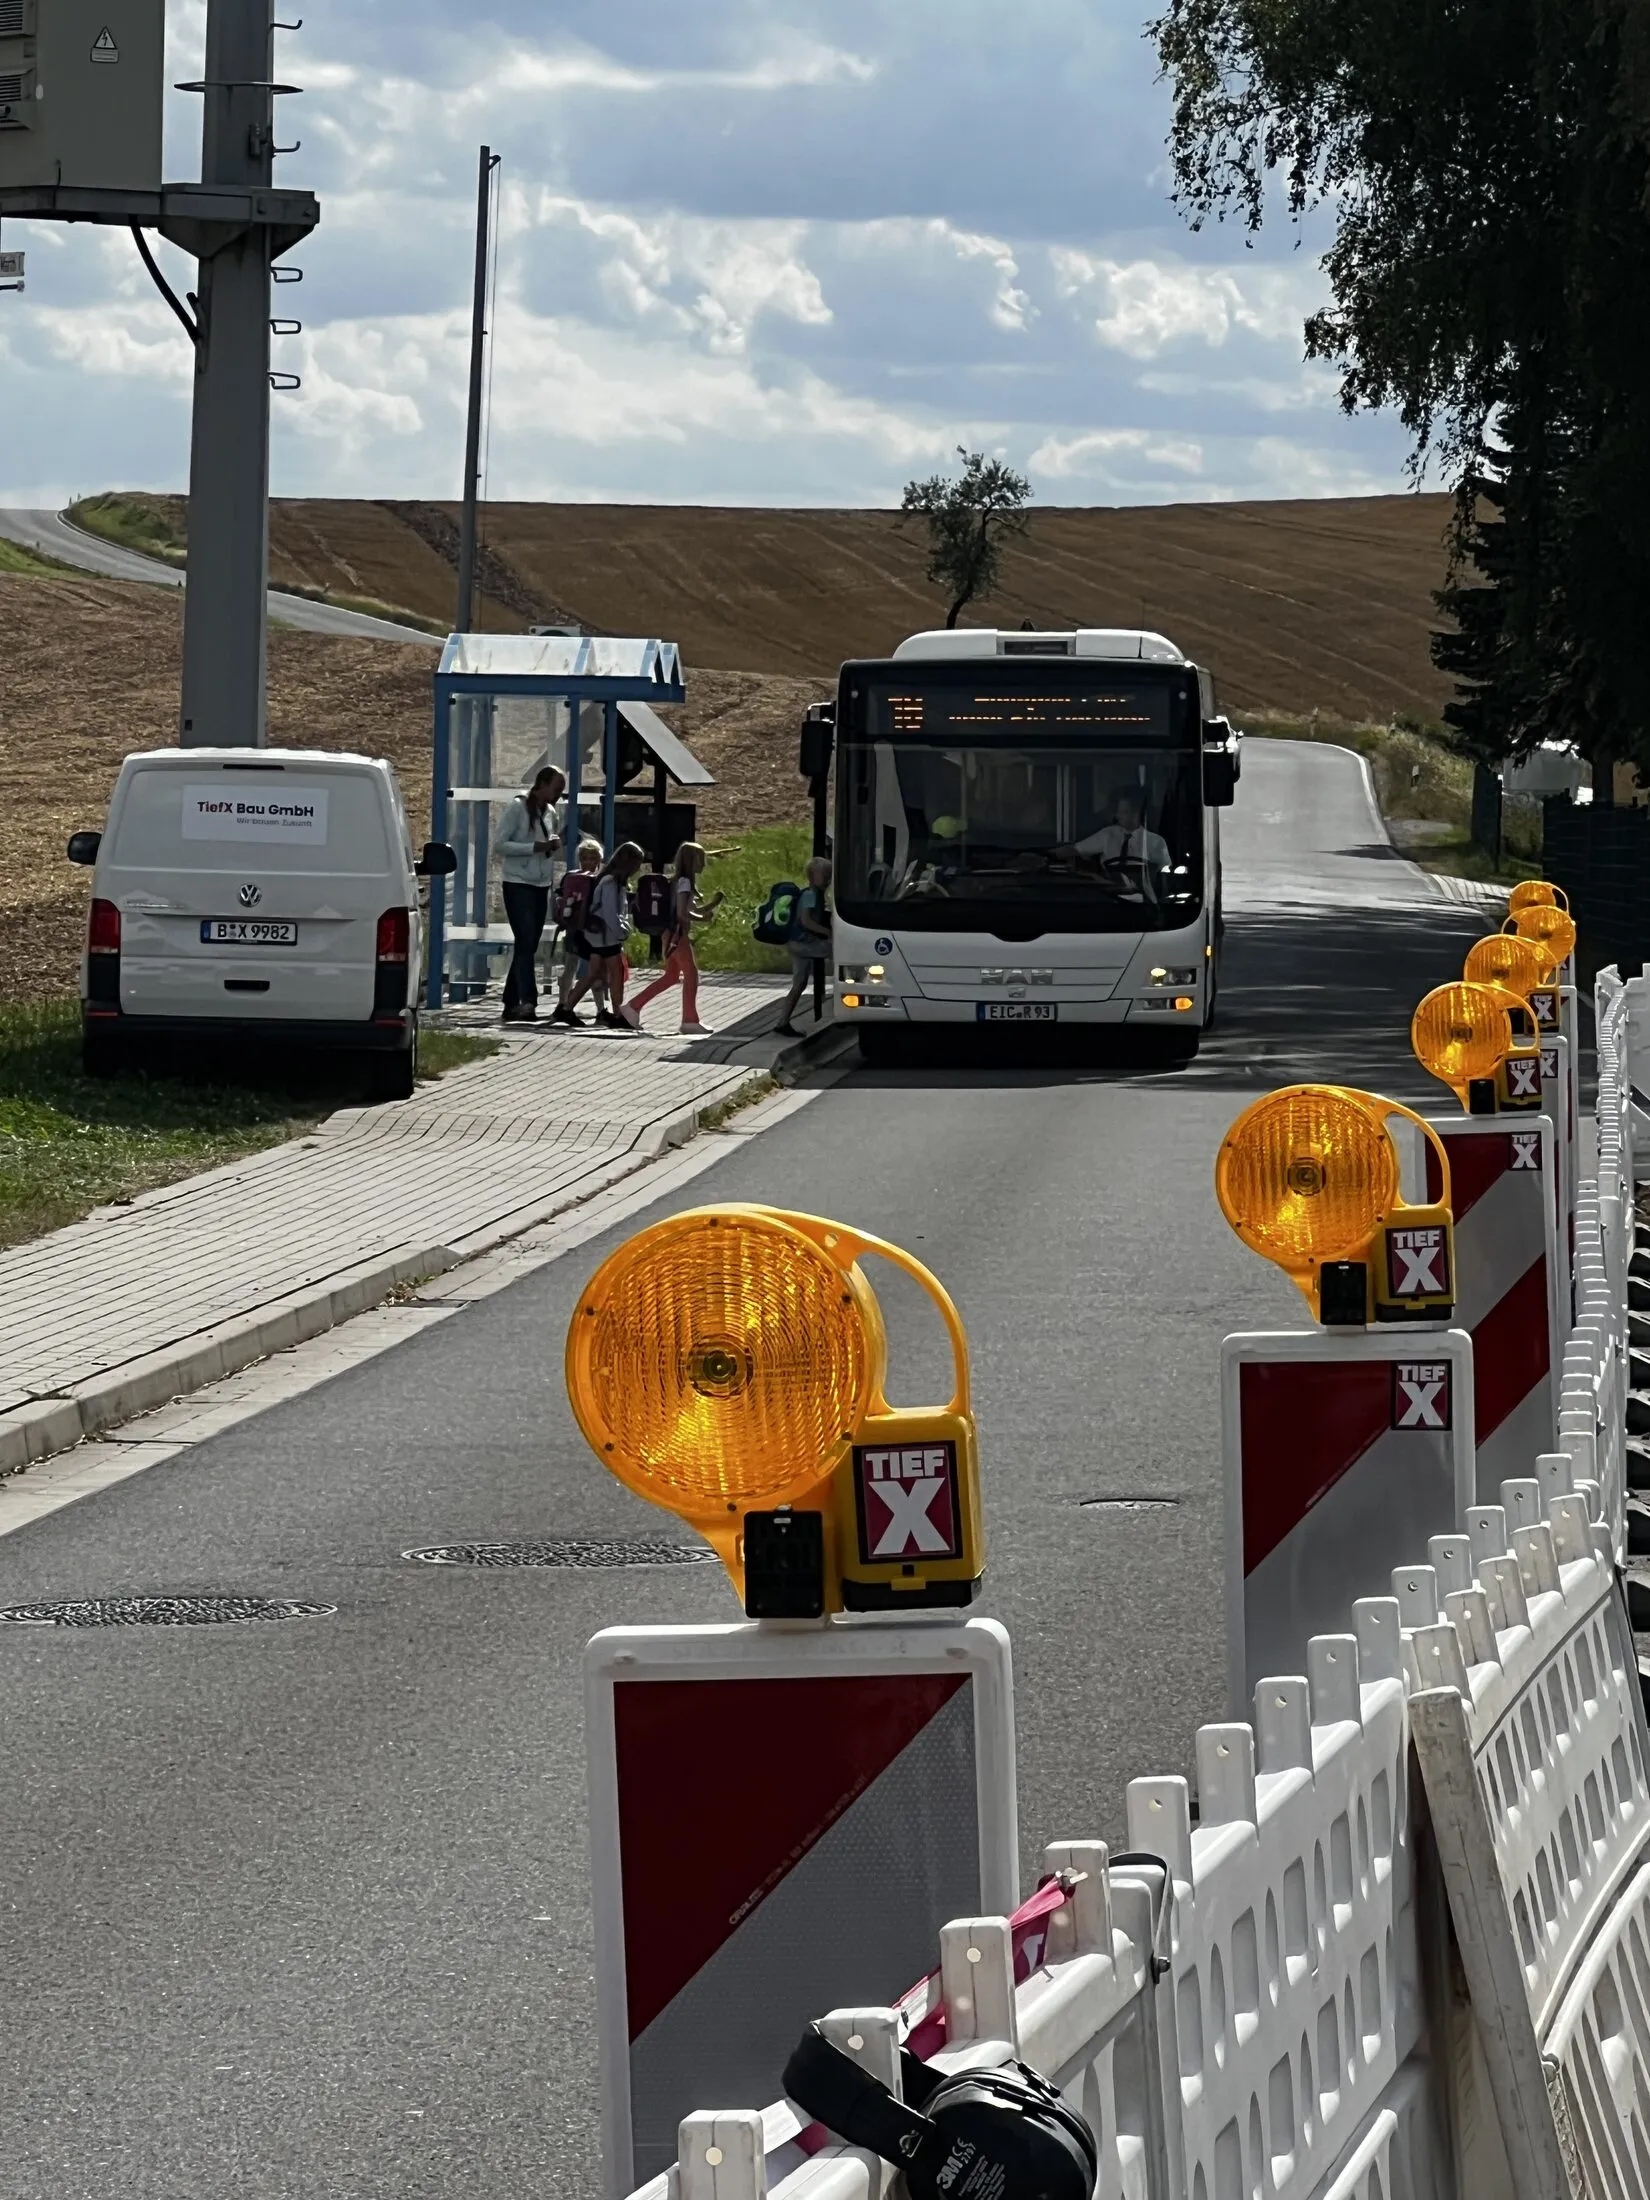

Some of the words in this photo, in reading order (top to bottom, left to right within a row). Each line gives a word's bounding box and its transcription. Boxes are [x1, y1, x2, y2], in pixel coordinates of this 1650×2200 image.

[197, 801, 233, 814] TiefX
[236, 803, 265, 815] Bau
[268, 804, 314, 817] GmbH
[217, 923, 227, 938] B
[238, 924, 247, 938] X
[251, 925, 290, 940] 9982
[1534, 1001, 1554, 1020] X
[1508, 1060, 1536, 1070] TIEF
[1510, 1069, 1538, 1095] X
[1512, 1134, 1538, 1144] TIEF
[1511, 1144, 1538, 1168] X
[1393, 1231, 1440, 1248] TIEF
[1394, 1247, 1443, 1293] X
[1398, 1366, 1445, 1382] TIEF
[1399, 1382, 1445, 1426] X
[865, 1449, 945, 1479] TIEF
[868, 1477, 951, 1555] X
[936, 2156, 963, 2189] 3M
